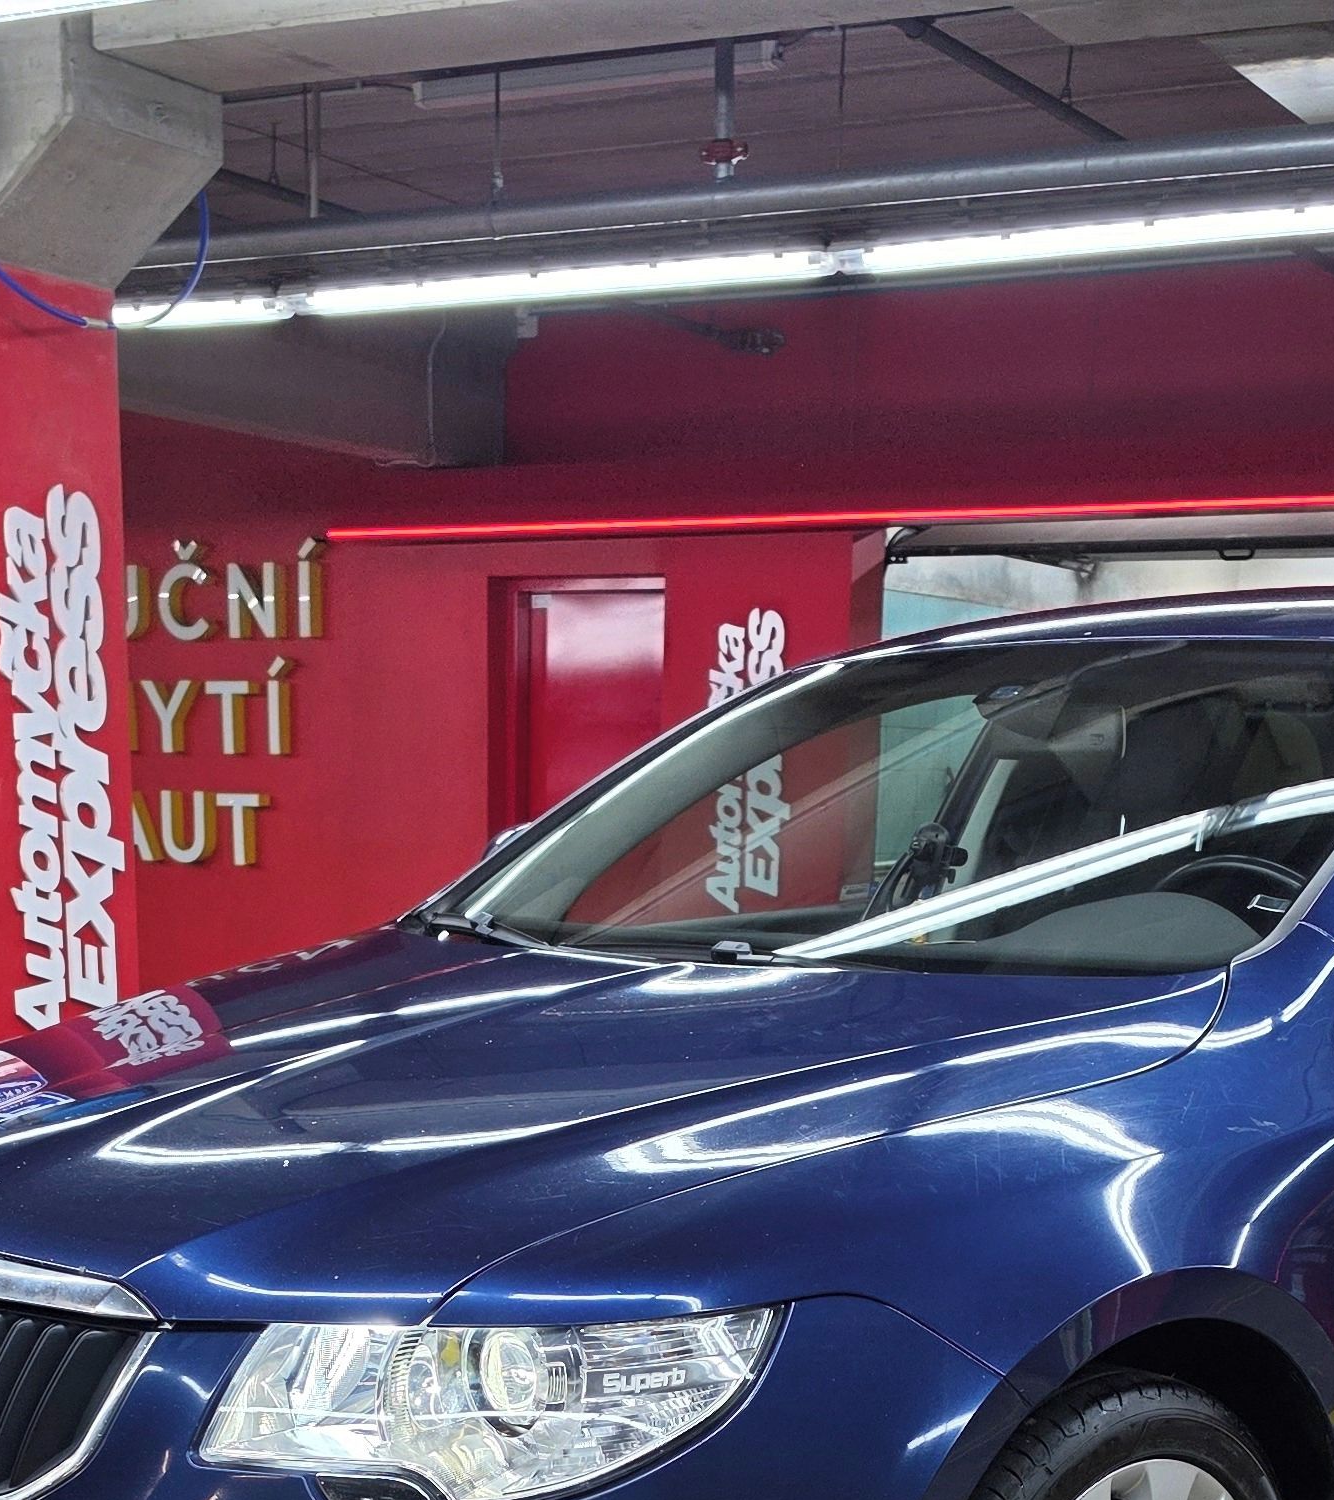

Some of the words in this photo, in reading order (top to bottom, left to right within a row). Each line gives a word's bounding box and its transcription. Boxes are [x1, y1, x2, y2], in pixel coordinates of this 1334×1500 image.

[46, 483, 124, 1007] Express
[129, 656, 291, 755] YTÍ
[603, 1365, 686, 1394] Superb
